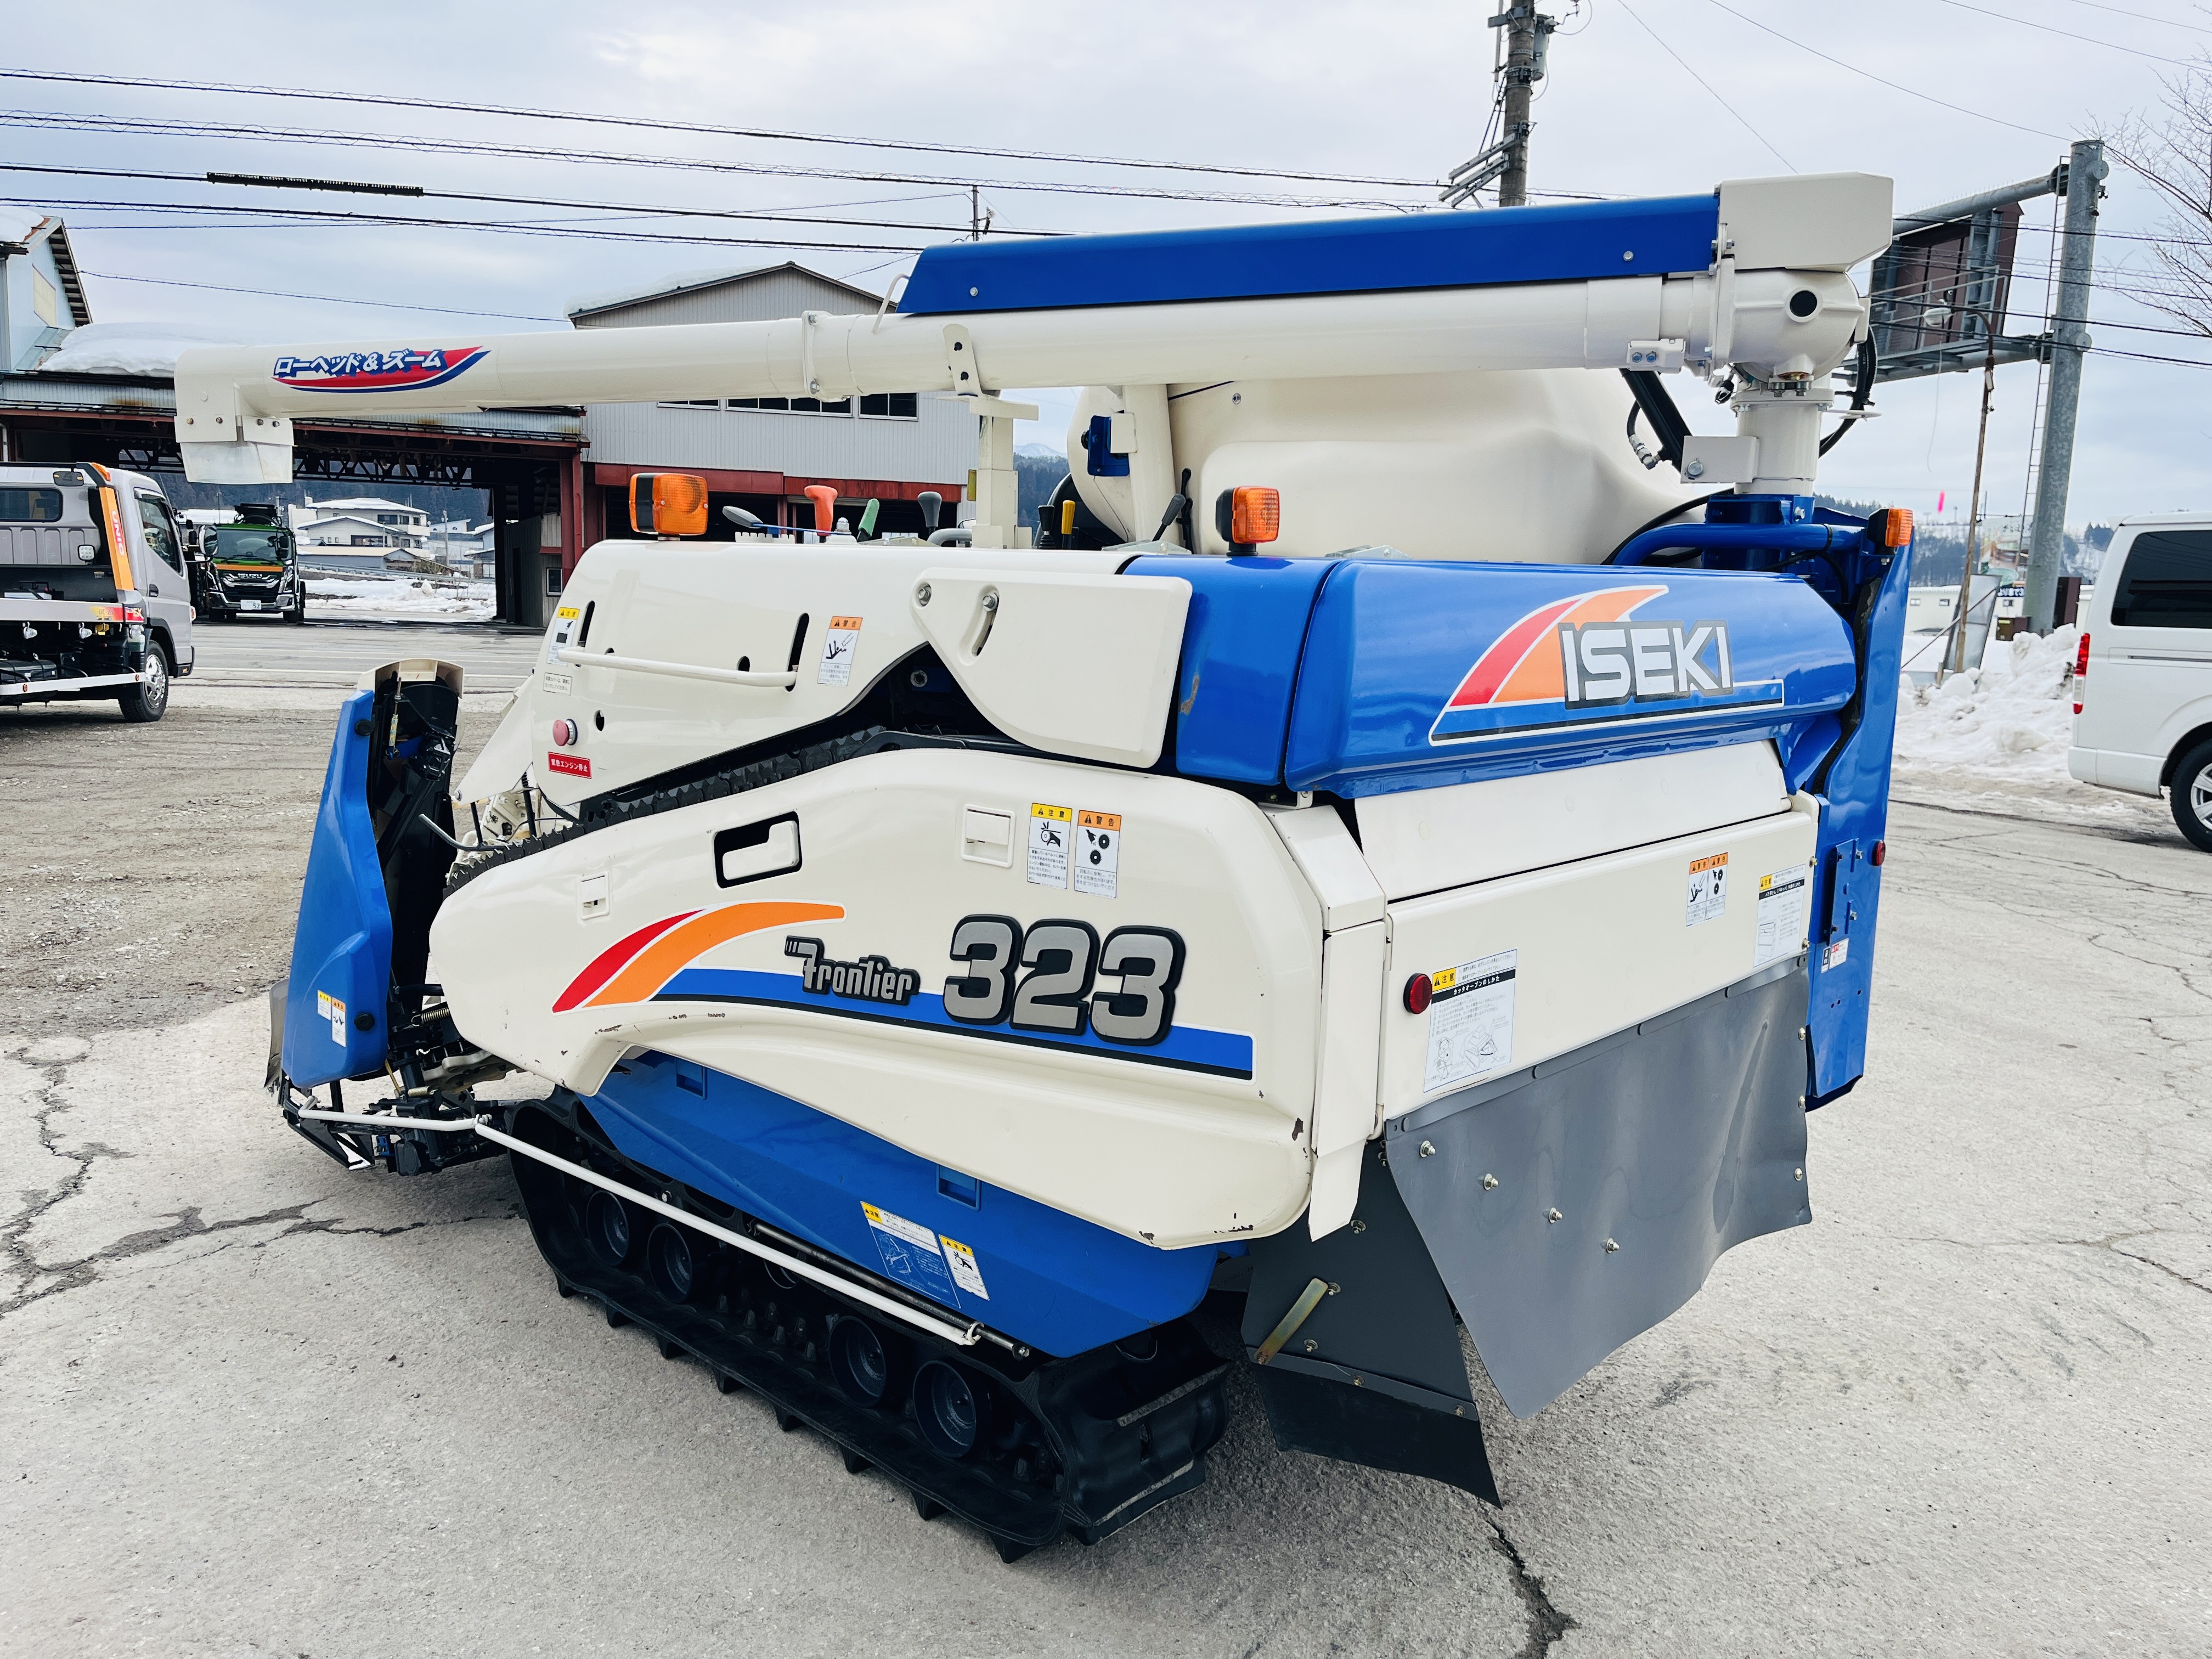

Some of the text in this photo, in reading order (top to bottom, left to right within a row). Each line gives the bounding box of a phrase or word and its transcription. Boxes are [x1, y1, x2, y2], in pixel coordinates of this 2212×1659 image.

[274, 349, 442, 374] ローヘッド&ズーム
[111, 510, 125, 556] UNIC
[1561, 627, 1731, 702] ISEKI
[1048, 809, 1065, 818] 注意
[1096, 815, 1115, 827] 警告
[785, 938, 915, 1003] Frontier
[944, 916, 1183, 1045] 323
[1441, 973, 1454, 984] 注意
